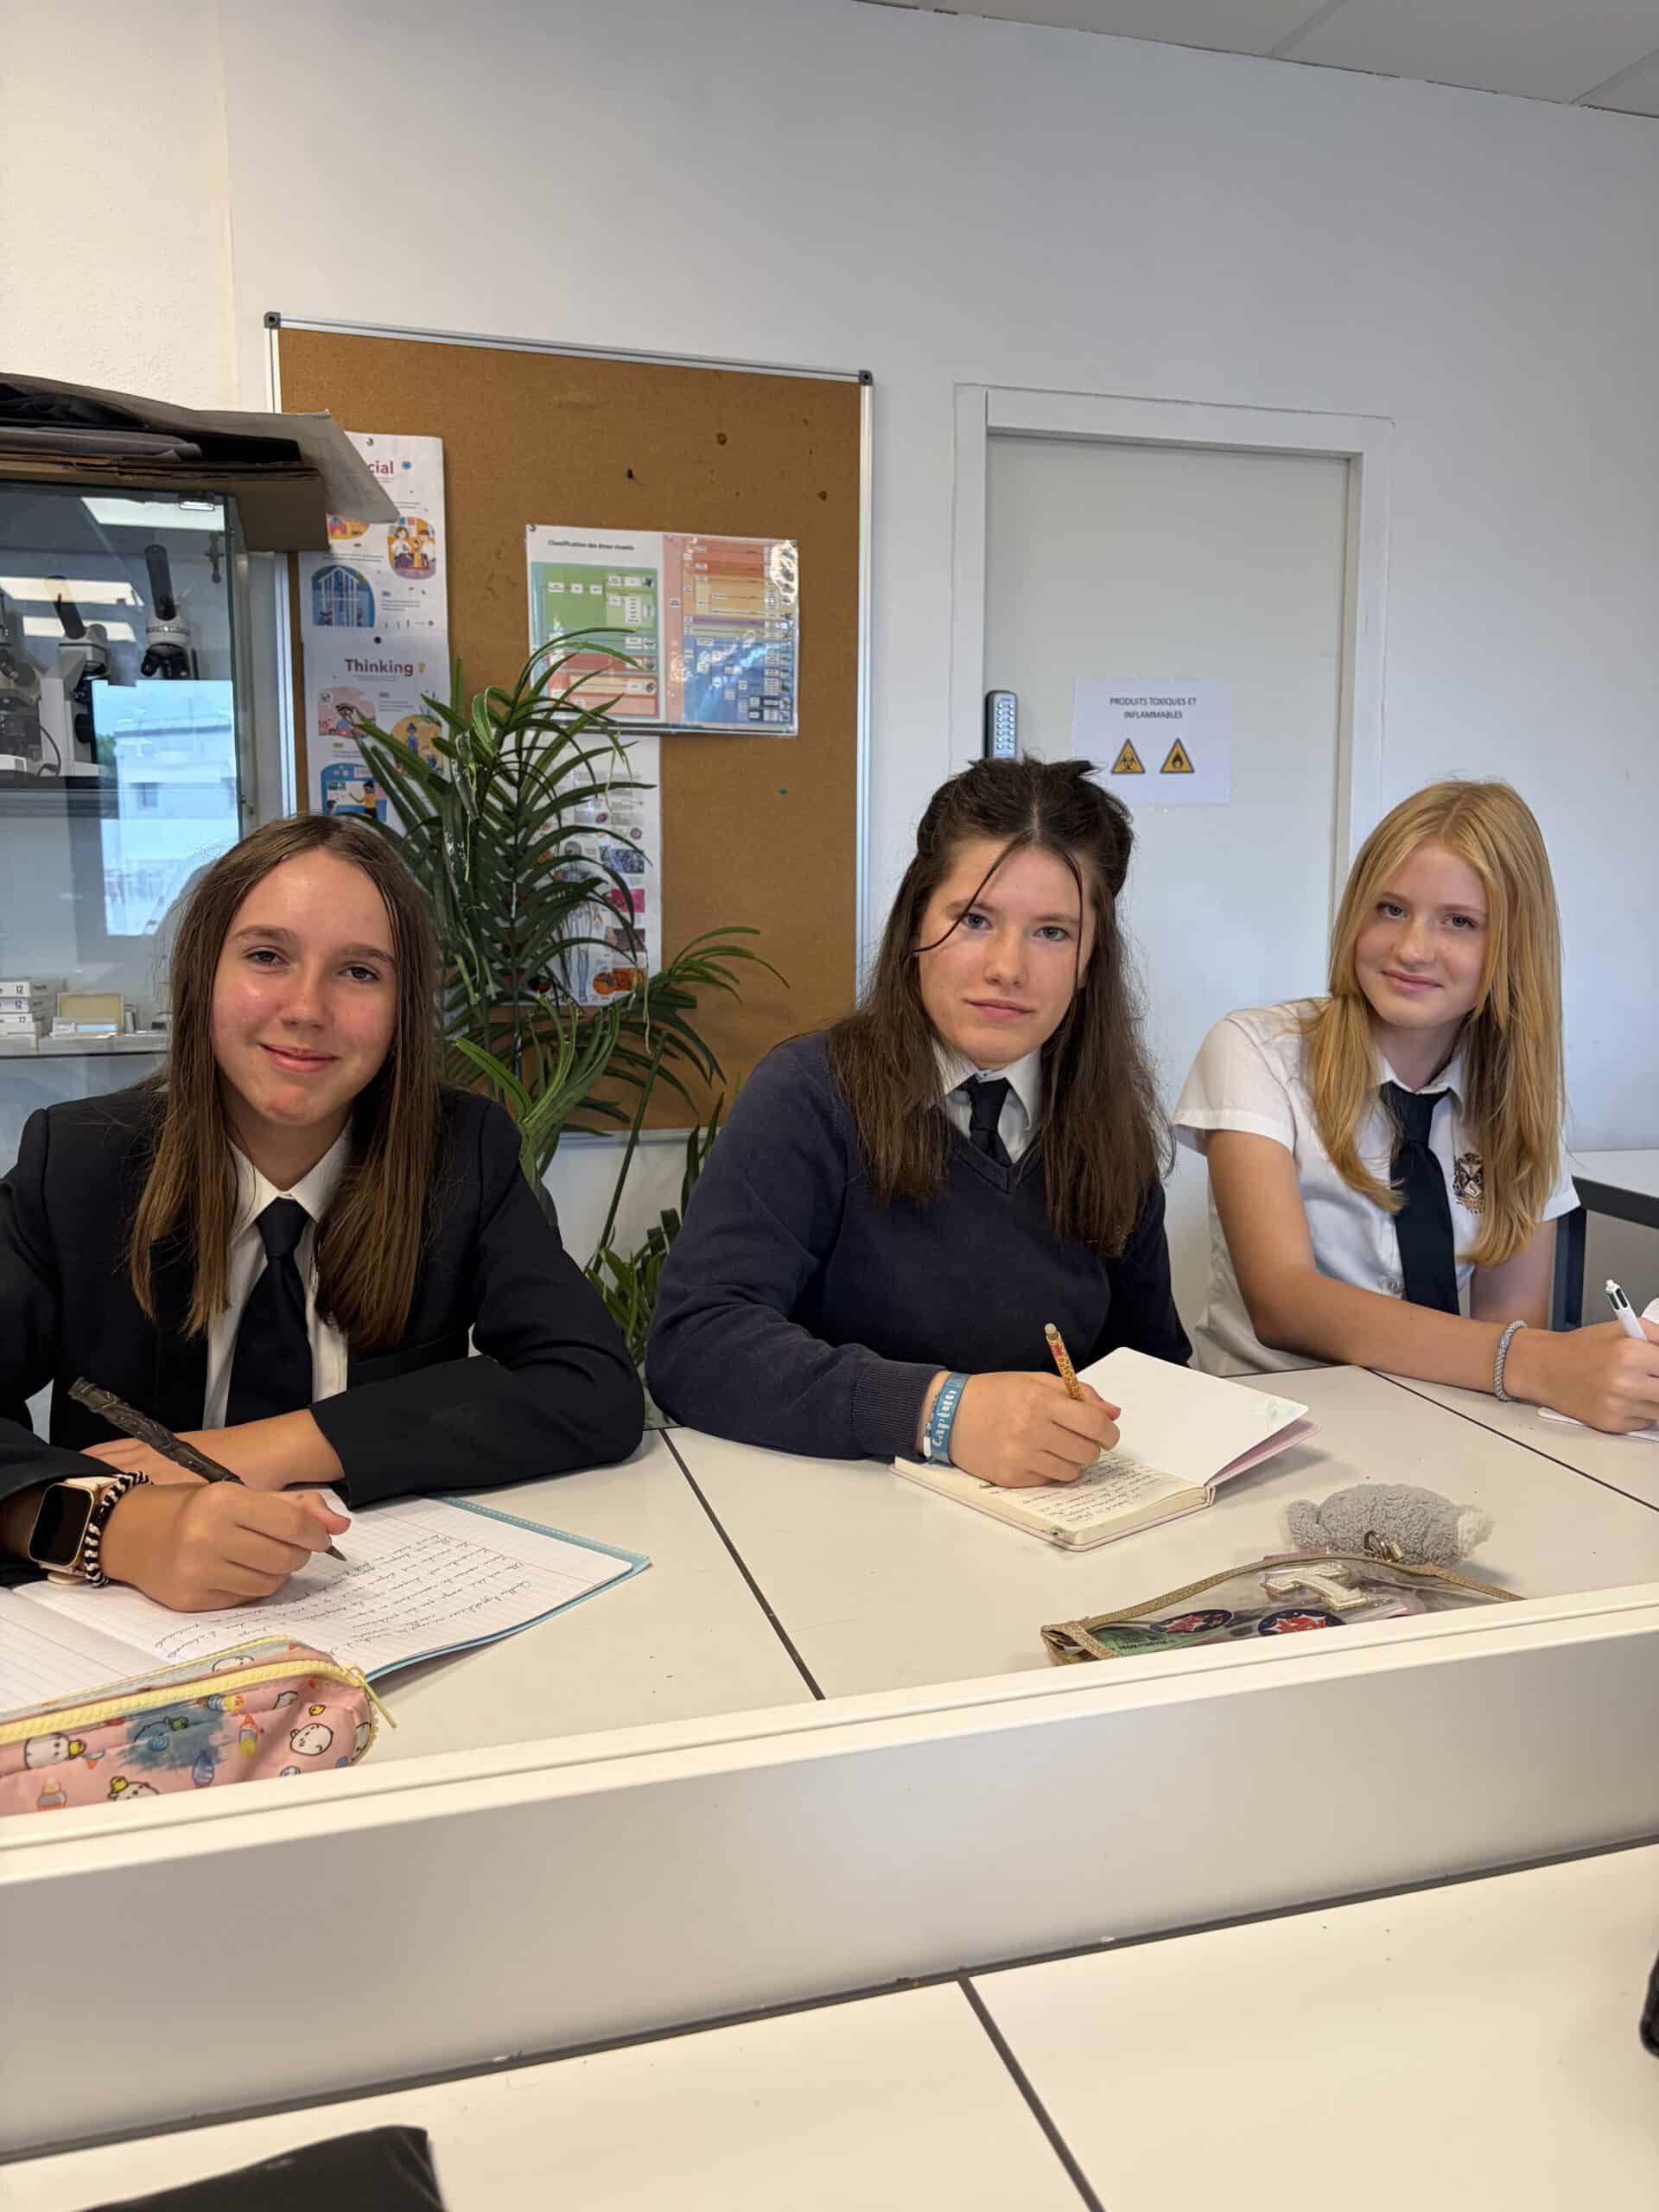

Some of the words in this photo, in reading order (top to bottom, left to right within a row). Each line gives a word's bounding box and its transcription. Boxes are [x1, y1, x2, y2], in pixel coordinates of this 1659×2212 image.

[367, 460, 394, 474] cial
[345, 658, 414, 677] Thinking
[1109, 697, 1147, 706] PRODUITS
[1149, 697, 1186, 706] TOXIQUES
[1187, 697, 1197, 706] ET
